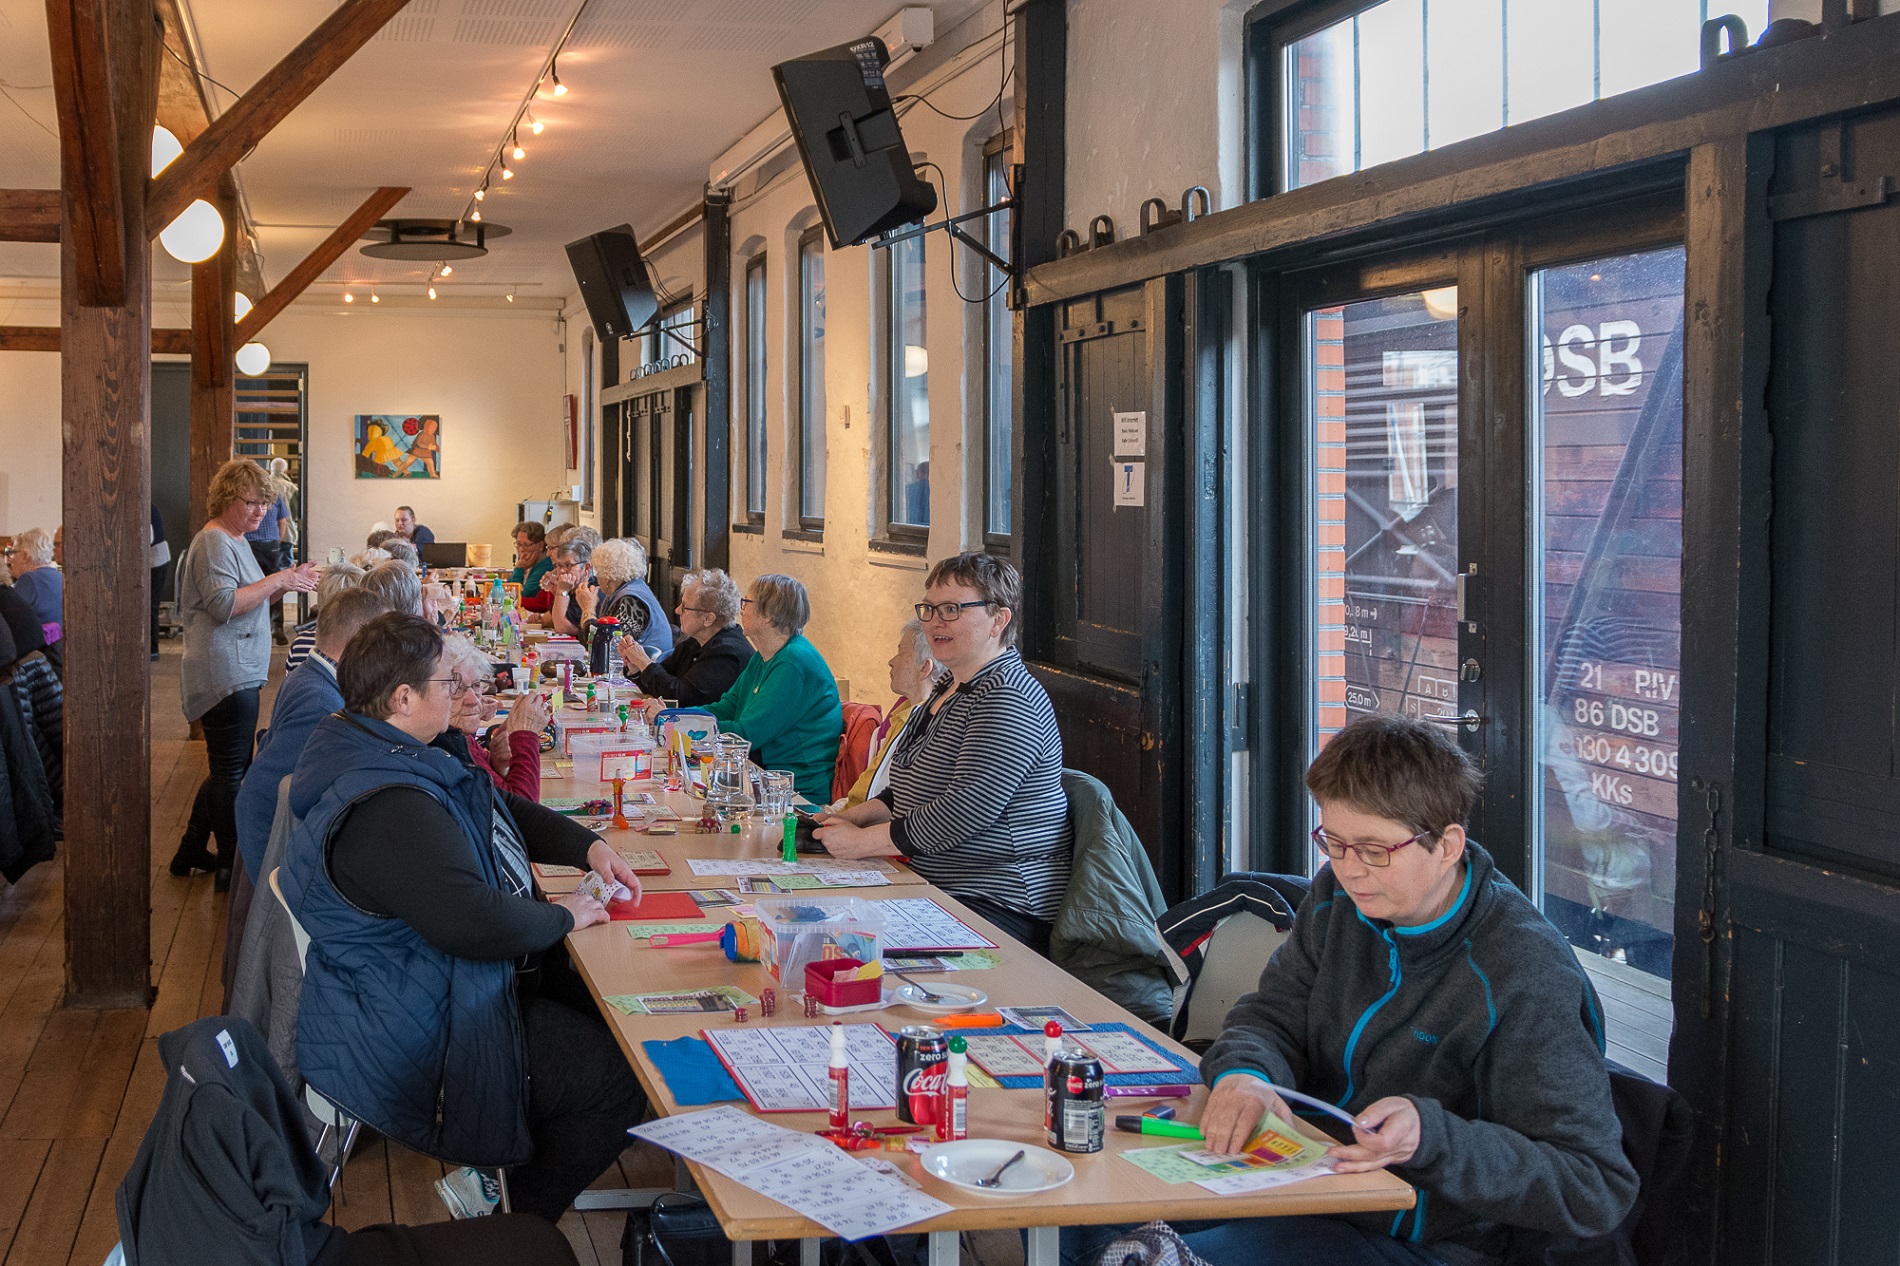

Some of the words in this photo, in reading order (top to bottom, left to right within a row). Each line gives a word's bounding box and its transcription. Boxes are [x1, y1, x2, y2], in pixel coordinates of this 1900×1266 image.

[1580, 662, 1602, 690] 21
[1575, 698, 1604, 726] 86
[1611, 704, 1660, 736] DSB
[1592, 772, 1633, 804] KKs
[920, 1052, 941, 1061] zero
